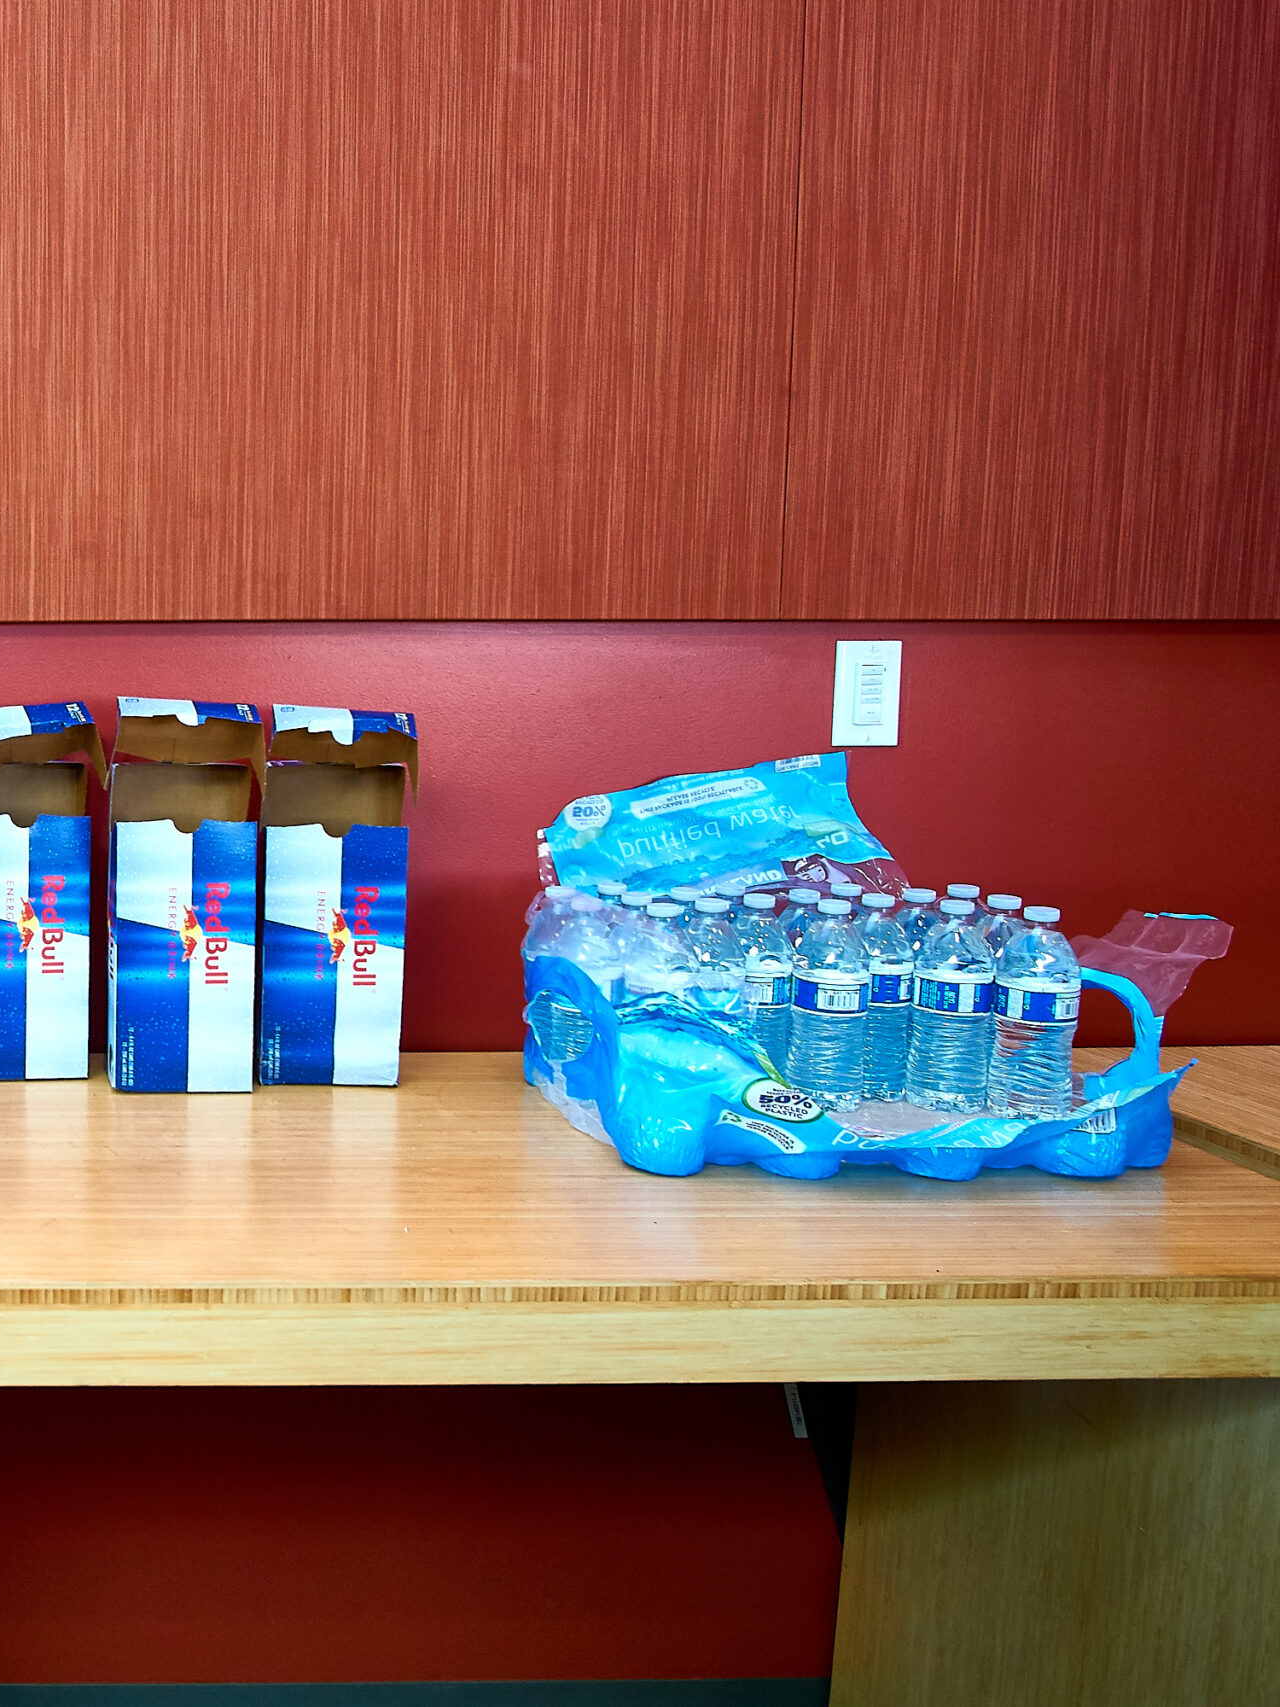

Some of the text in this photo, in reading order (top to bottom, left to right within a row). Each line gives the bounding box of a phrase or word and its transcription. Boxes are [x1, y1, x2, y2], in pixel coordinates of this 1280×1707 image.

[6, 880, 14, 969] ENERGY DRINK
[41, 875, 66, 974] Red Bull
[168, 888, 176, 979] ENERGY DRINK
[205, 882, 230, 984] Red Bull
[315, 891, 326, 980] ENERGY DRINK
[353, 886, 379, 985] Red Bull
[759, 1094, 812, 1108] 50%
[761, 1104, 808, 1115] RECYCLED
[765, 1108, 803, 1119] PLASTIC
